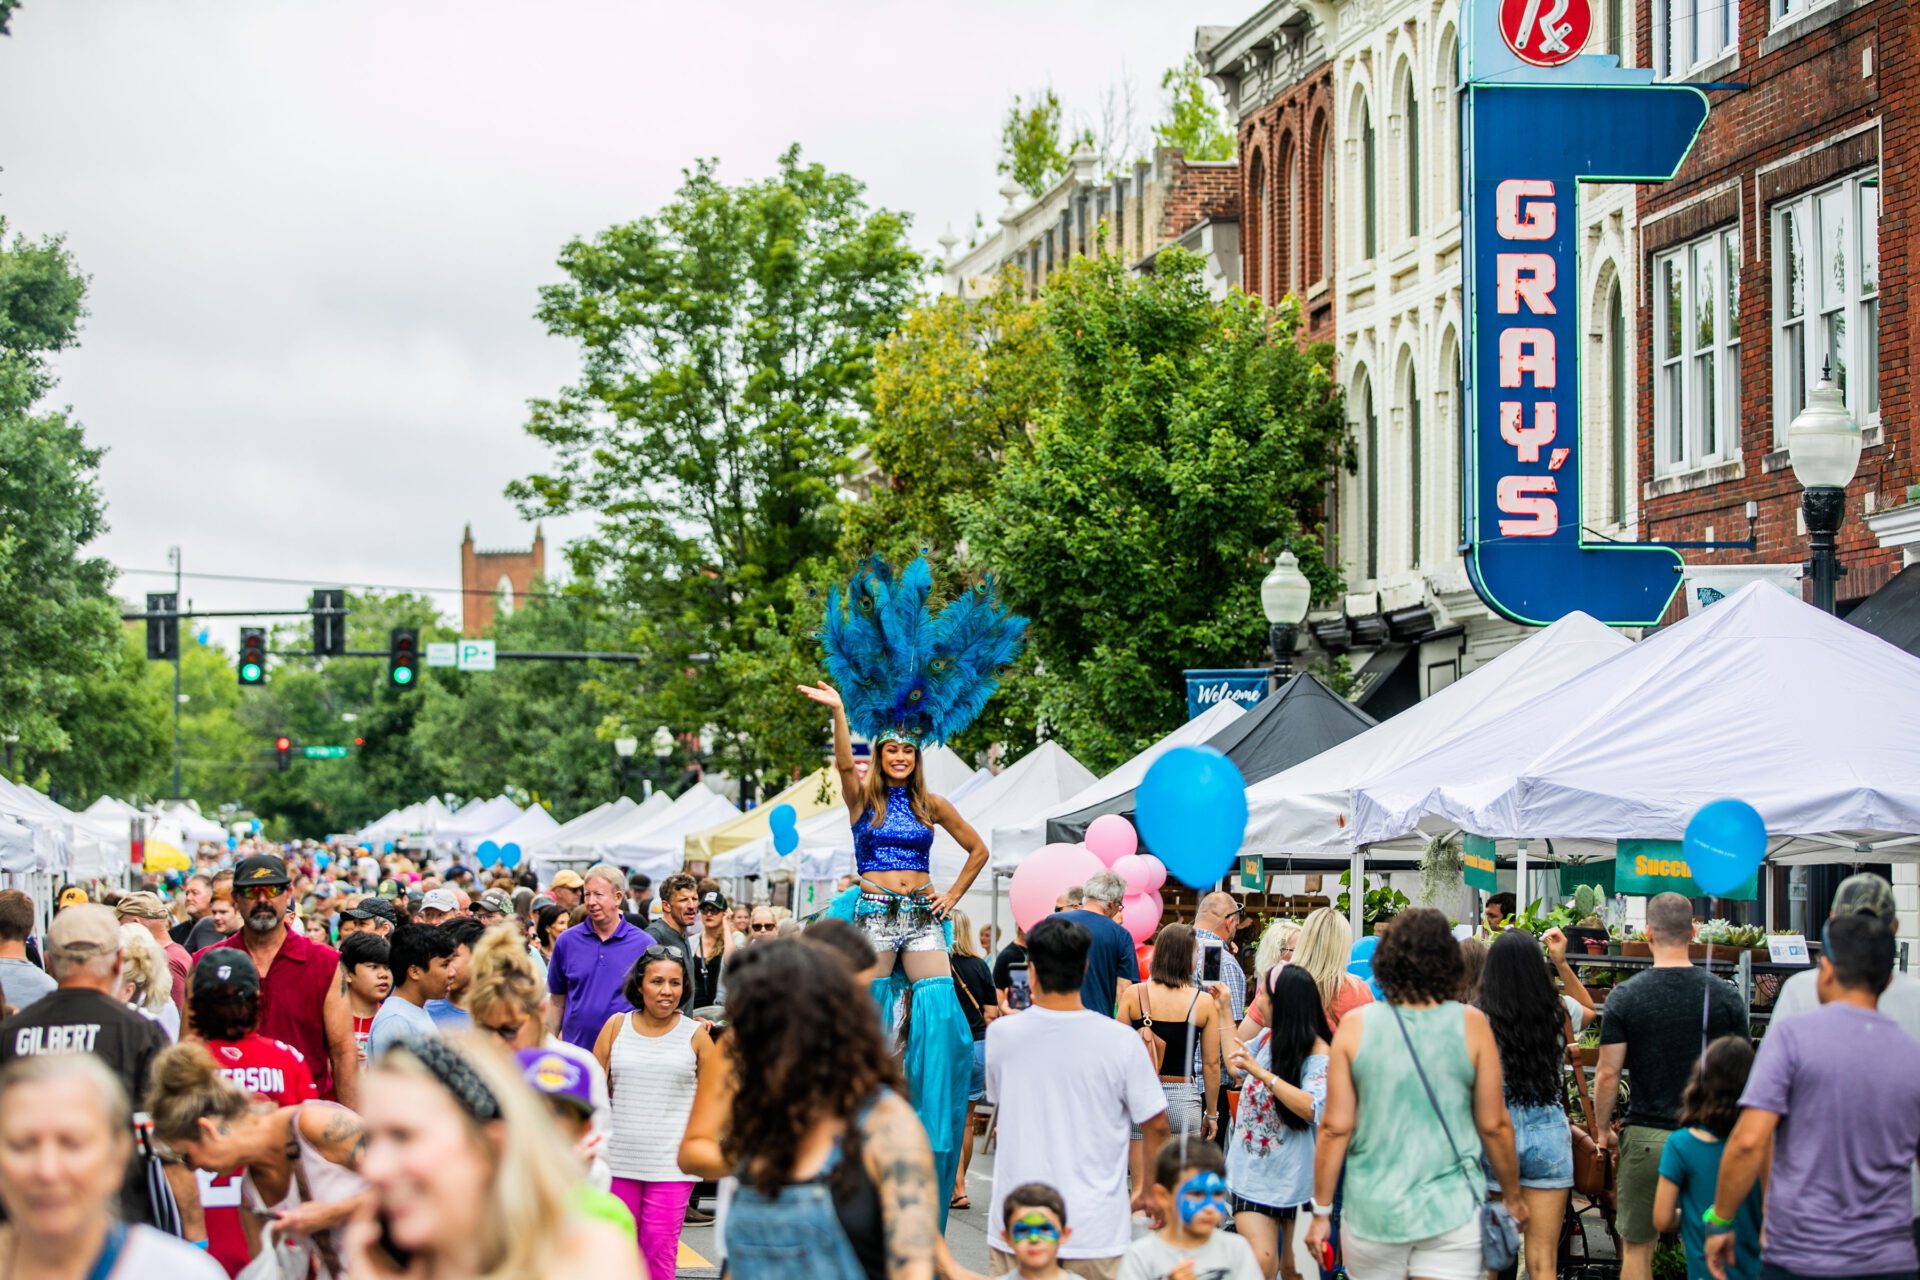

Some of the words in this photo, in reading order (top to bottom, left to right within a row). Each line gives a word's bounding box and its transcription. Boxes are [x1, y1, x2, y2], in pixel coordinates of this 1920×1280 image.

[1496, 178, 1571, 537] GRAY'S
[1197, 681, 1261, 704] Welcome
[1635, 854, 1693, 878] Succu
[15, 1023, 102, 1057] GILBERT
[213, 1066, 285, 1093] ERSON
